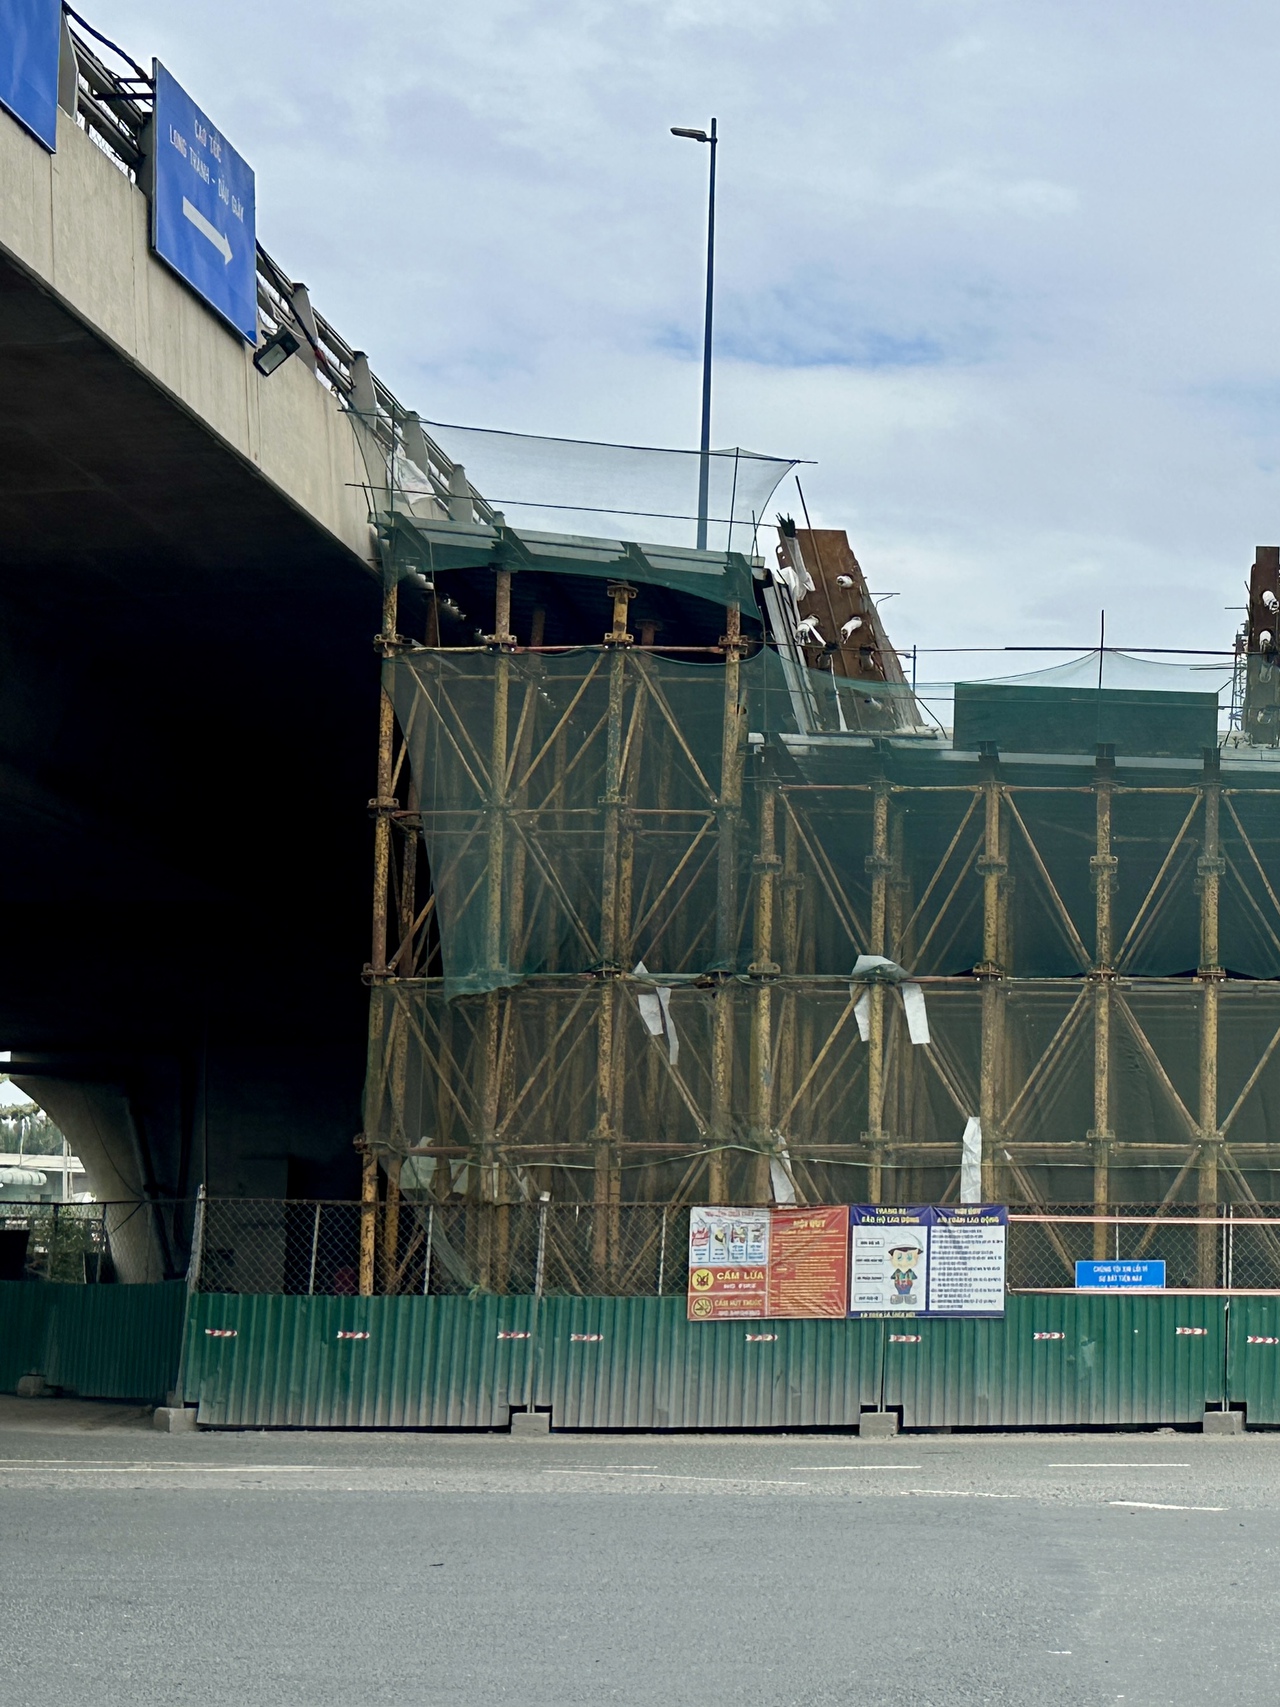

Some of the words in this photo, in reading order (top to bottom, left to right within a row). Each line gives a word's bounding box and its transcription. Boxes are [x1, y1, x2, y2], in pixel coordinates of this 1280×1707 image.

[169, 123, 187, 158] LONG
[716, 1269, 739, 1280] CẤM
[743, 1269, 764, 1280] LỬA
